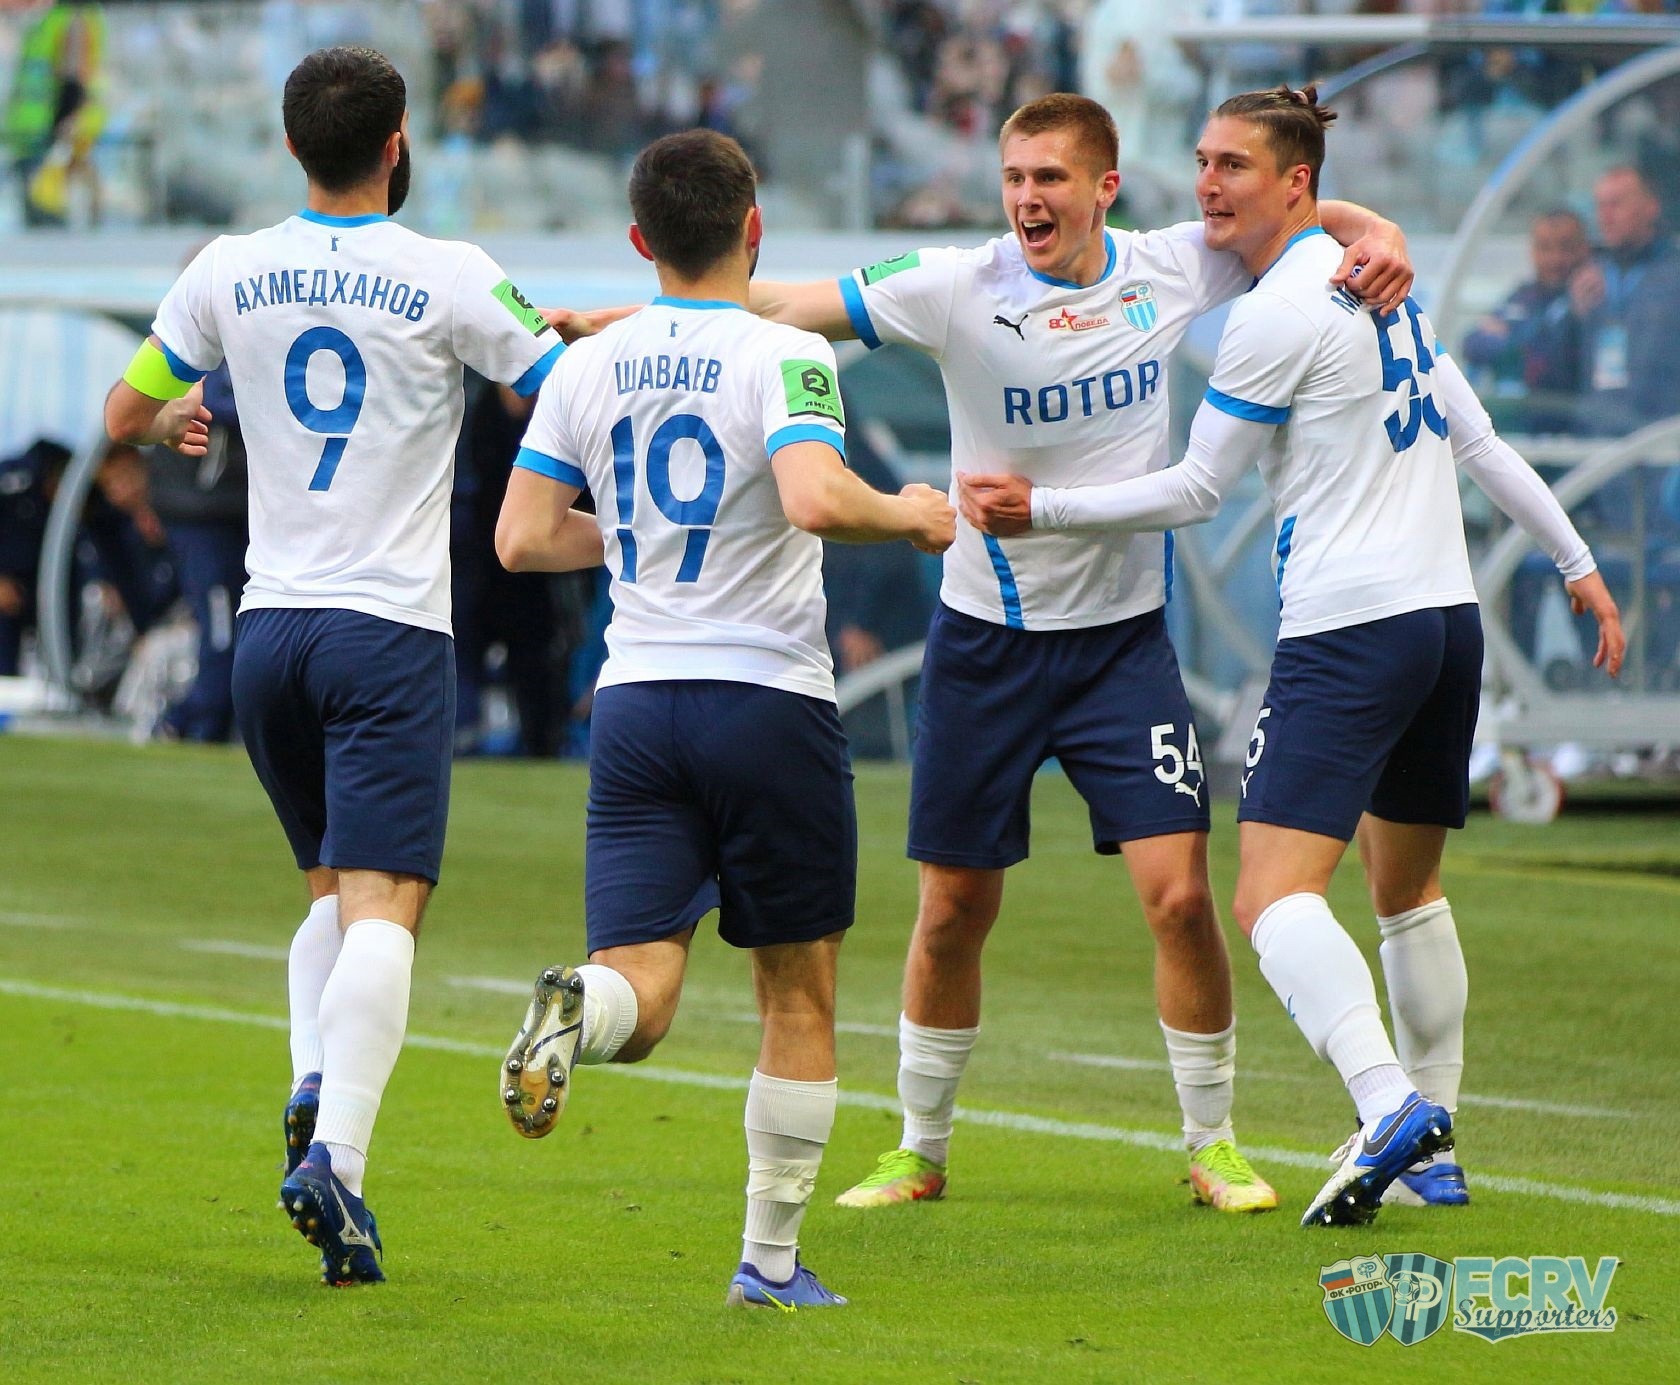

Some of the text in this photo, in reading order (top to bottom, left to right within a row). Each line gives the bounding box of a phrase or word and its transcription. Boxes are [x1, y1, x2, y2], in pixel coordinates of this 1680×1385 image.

[234, 269, 430, 323] АХМЕДХАНОВ
[284, 326, 367, 491] 9
[1003, 359, 1160, 426] ROTOR
[1370, 296, 1448, 453] 55
[610, 413, 726, 584] 19
[1150, 722, 1204, 785] 54
